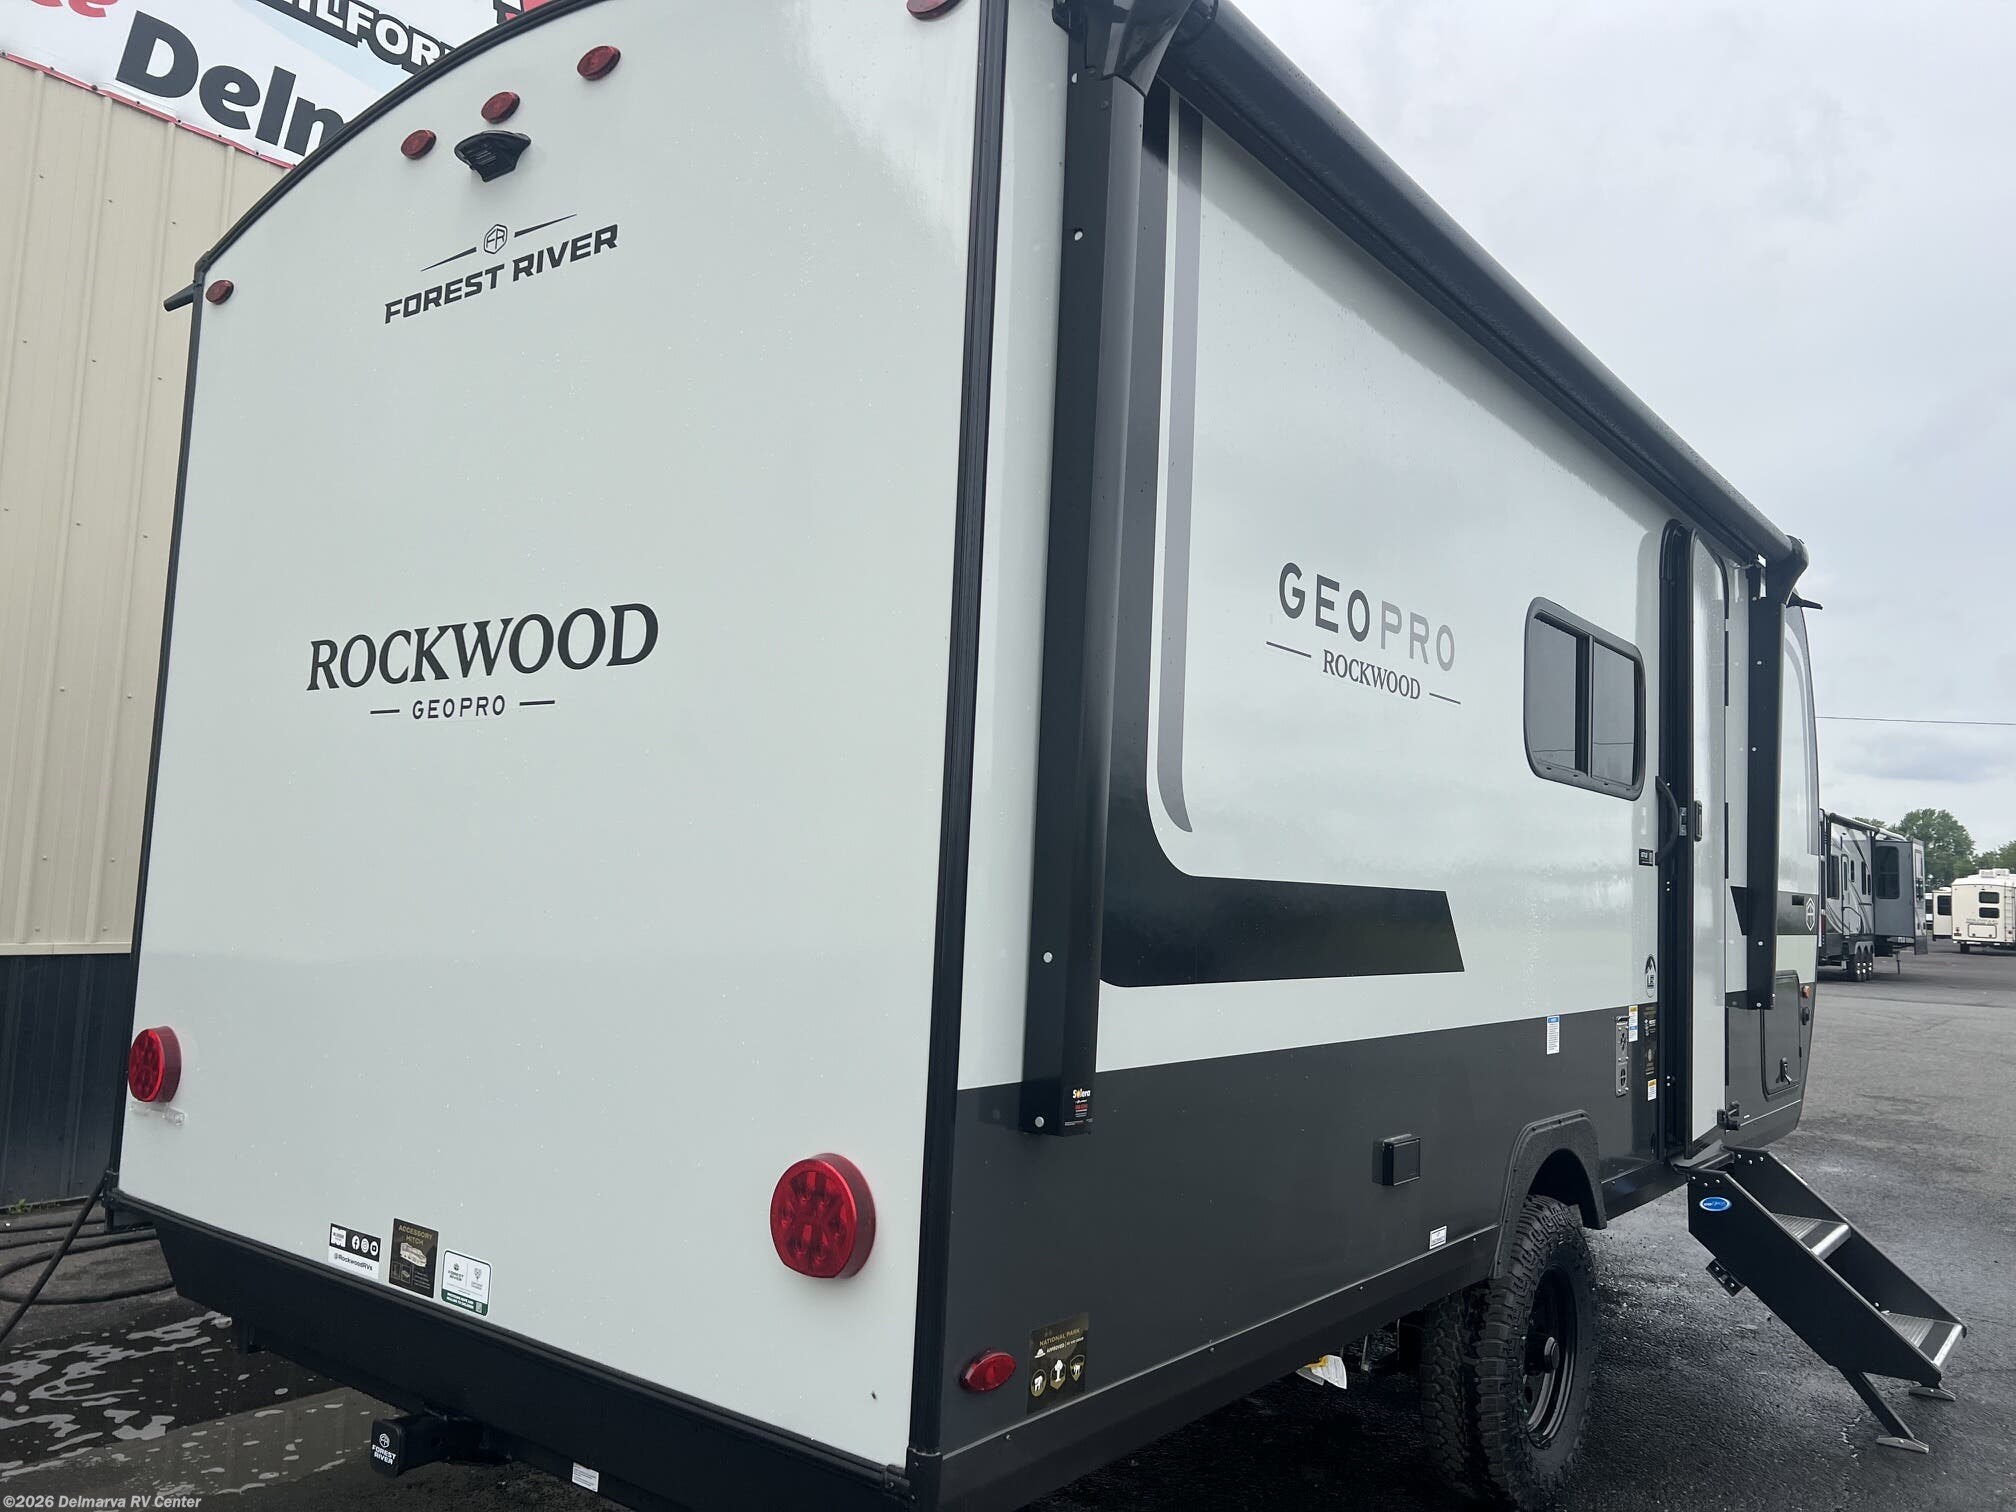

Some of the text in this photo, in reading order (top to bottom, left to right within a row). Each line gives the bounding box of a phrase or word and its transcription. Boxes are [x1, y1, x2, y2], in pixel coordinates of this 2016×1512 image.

[385, 224, 618, 324] FOREST RIVER
[306, 602, 660, 691] ROCKWOOD
[1322, 649, 1421, 700] ROCKWOOD
[411, 694, 506, 720] GEOPRO
[398, 1225, 433, 1241] ACCESSORY
[405, 1234, 424, 1246] HITCH
[372, 1444, 397, 1460] FOREST
[374, 1451, 394, 1465] RIVER
